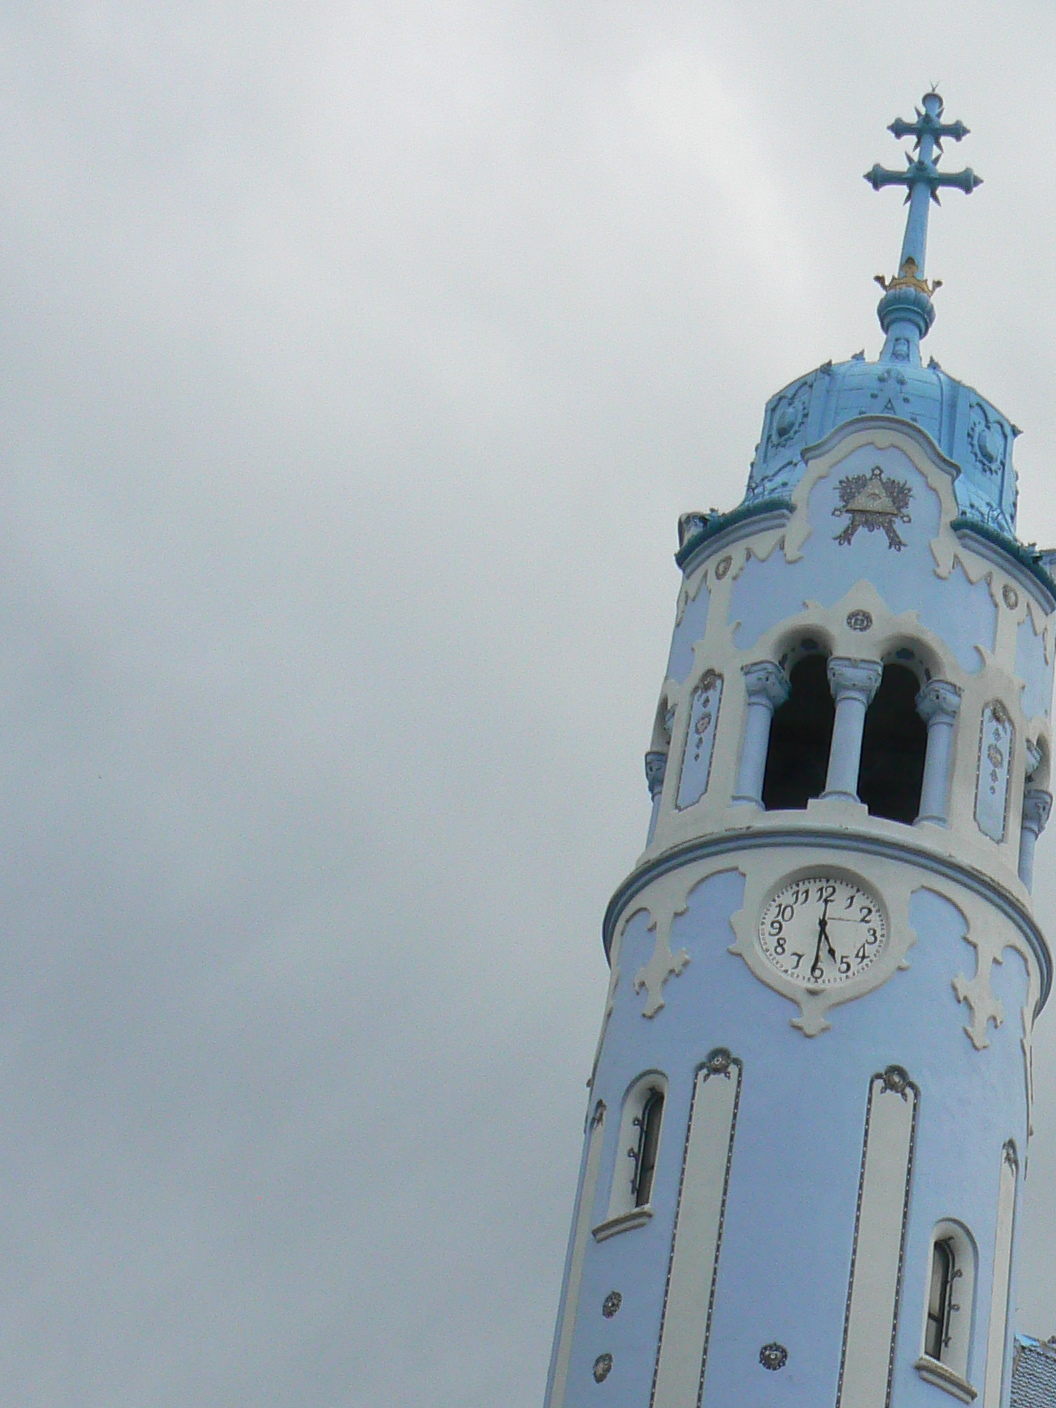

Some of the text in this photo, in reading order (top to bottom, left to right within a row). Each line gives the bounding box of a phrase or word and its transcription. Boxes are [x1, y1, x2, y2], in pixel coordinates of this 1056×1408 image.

[791, 888, 810, 906] 11
[816, 885, 837, 904] 12
[844, 895, 857, 910] 1
[774, 903, 795, 923] 10
[859, 906, 873, 924] 2
[768, 919, 783, 937] 9
[865, 928, 878, 945] 3
[774, 937, 787, 956] 8
[854, 943, 870, 966] 4
[790, 952, 806, 970] 7
[838, 955, 851, 974] 5
[810, 963, 824, 980] 6
